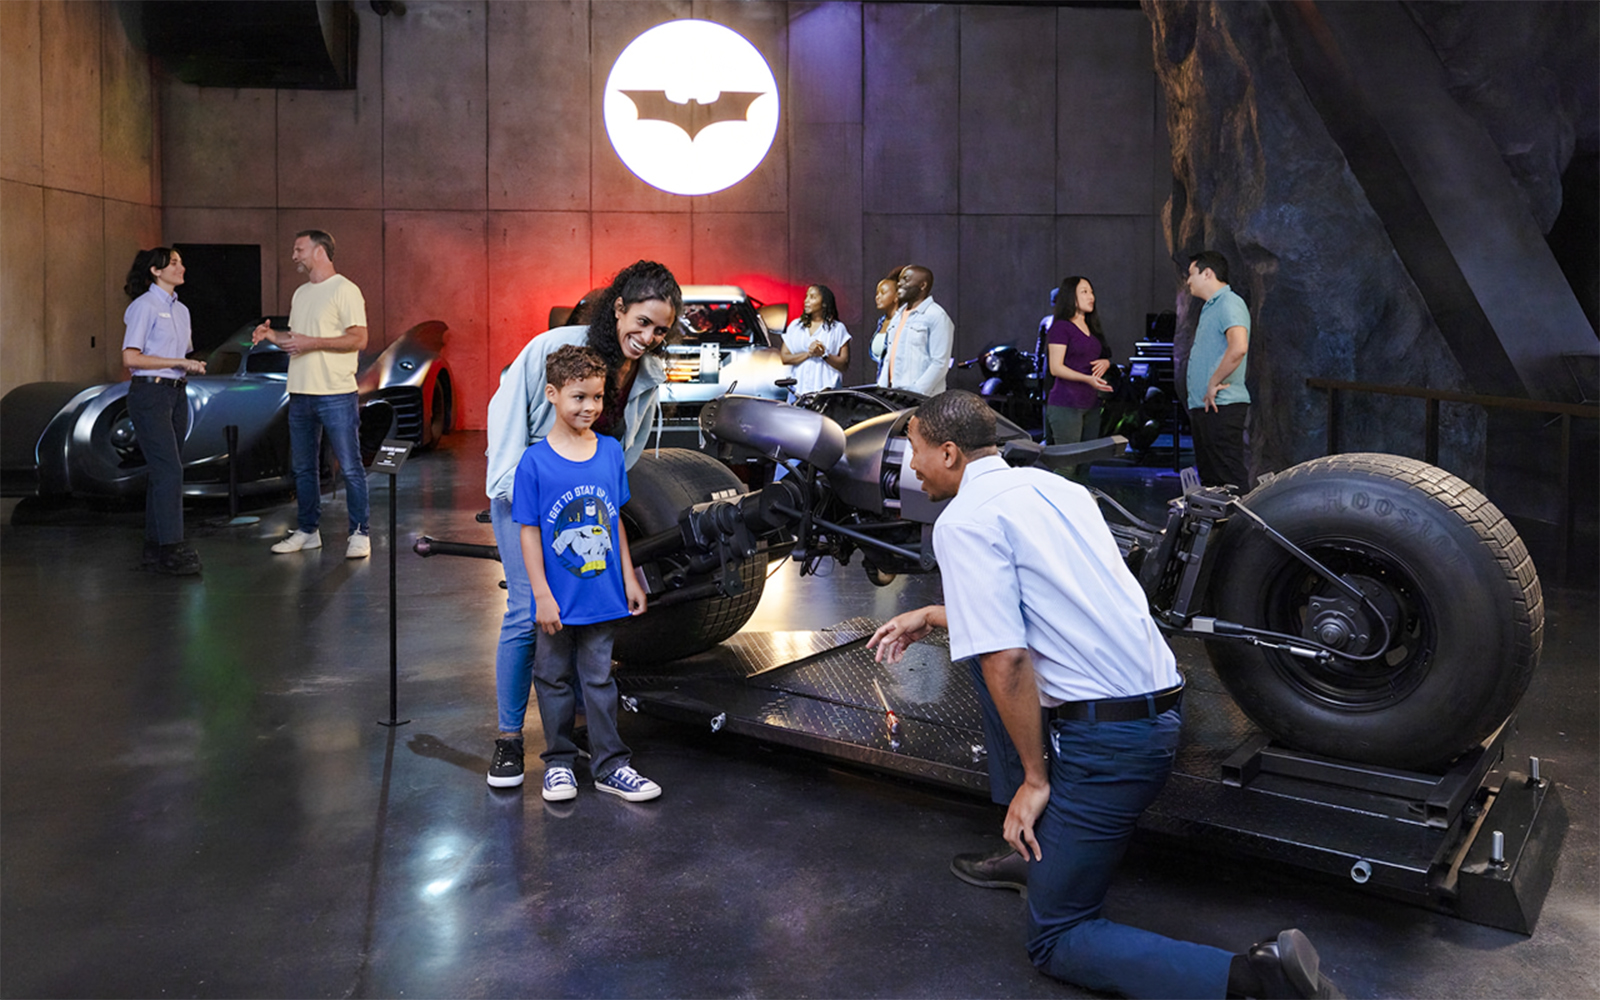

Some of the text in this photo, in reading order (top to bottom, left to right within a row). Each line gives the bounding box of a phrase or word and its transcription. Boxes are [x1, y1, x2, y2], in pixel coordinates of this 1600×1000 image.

[549, 499, 563, 519] GET
[561, 490, 573, 503] TO
[574, 485, 595, 497] STAY
